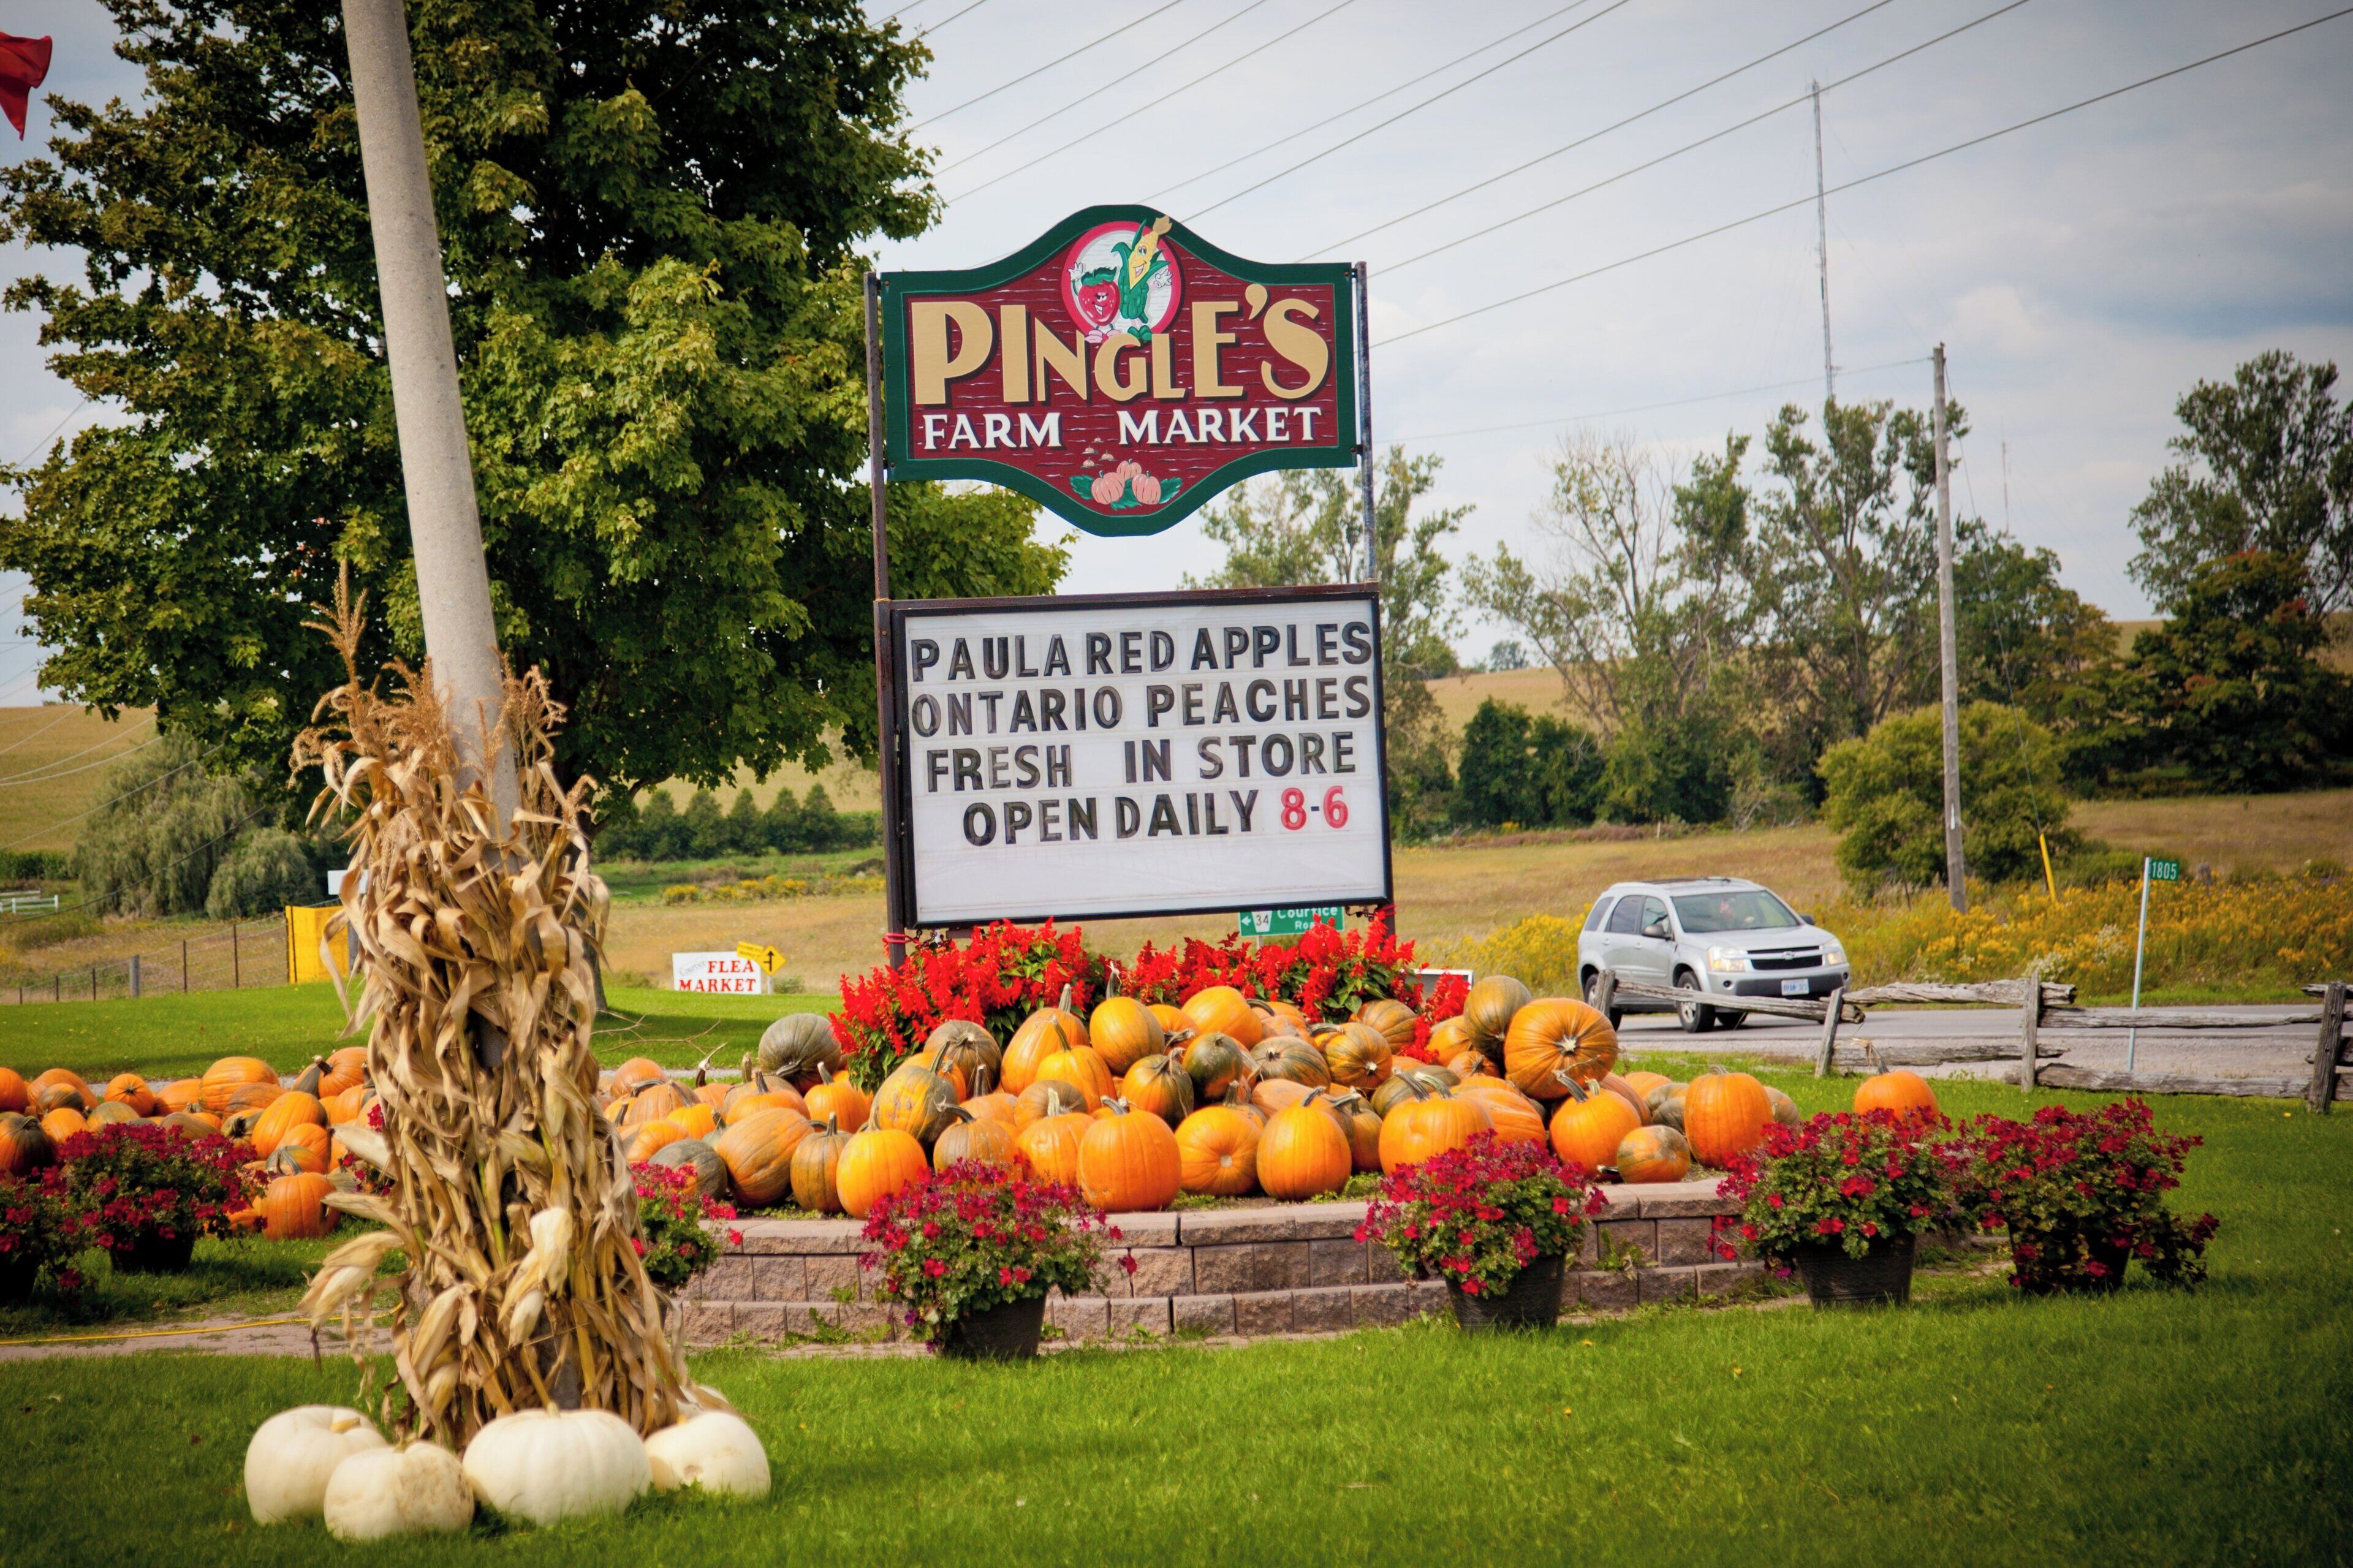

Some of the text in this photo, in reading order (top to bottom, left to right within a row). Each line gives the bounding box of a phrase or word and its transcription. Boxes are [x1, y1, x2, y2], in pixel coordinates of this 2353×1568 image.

[911, 284, 1329, 404] PINGLE'S
[922, 407, 1323, 450] FARM MARKET
[911, 621, 1372, 682] PAULA RED APPLES
[912, 675, 1371, 737] ONTARIO PEACHES
[927, 732, 1356, 793] FRESH IN STORE
[963, 786, 1349, 847] OPEN DAILY 8-6
[2151, 862, 2177, 880] 1805
[1256, 914, 1269, 926] 34
[1295, 920, 1316, 930] Roa
[678, 979, 756, 992] MARKET
[708, 960, 755, 973] FLEA
